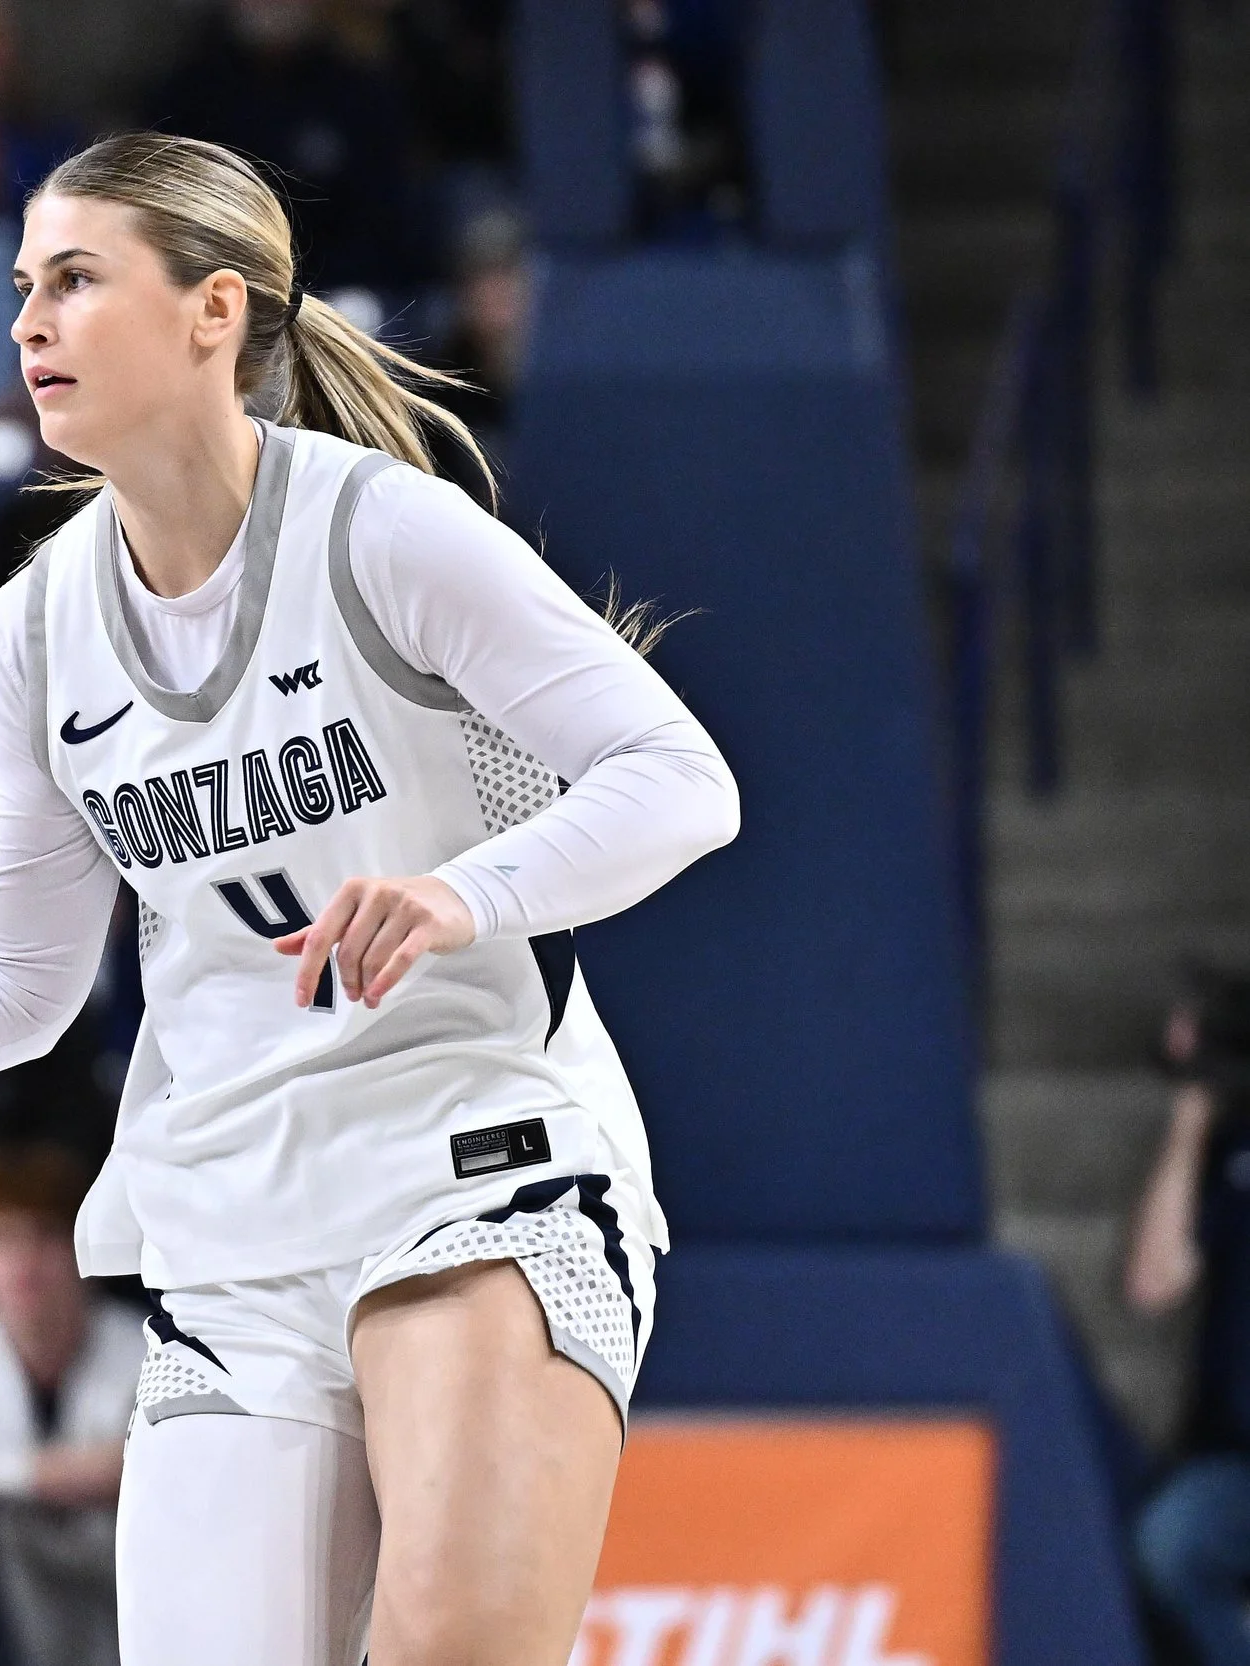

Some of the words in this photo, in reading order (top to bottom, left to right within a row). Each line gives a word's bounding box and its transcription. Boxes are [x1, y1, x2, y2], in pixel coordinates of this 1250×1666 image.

[82, 717, 387, 869] GONZAGA
[209, 866, 338, 1015] 4
[521, 1135, 534, 1152] L
[566, 1584, 937, 1666] TIHL
